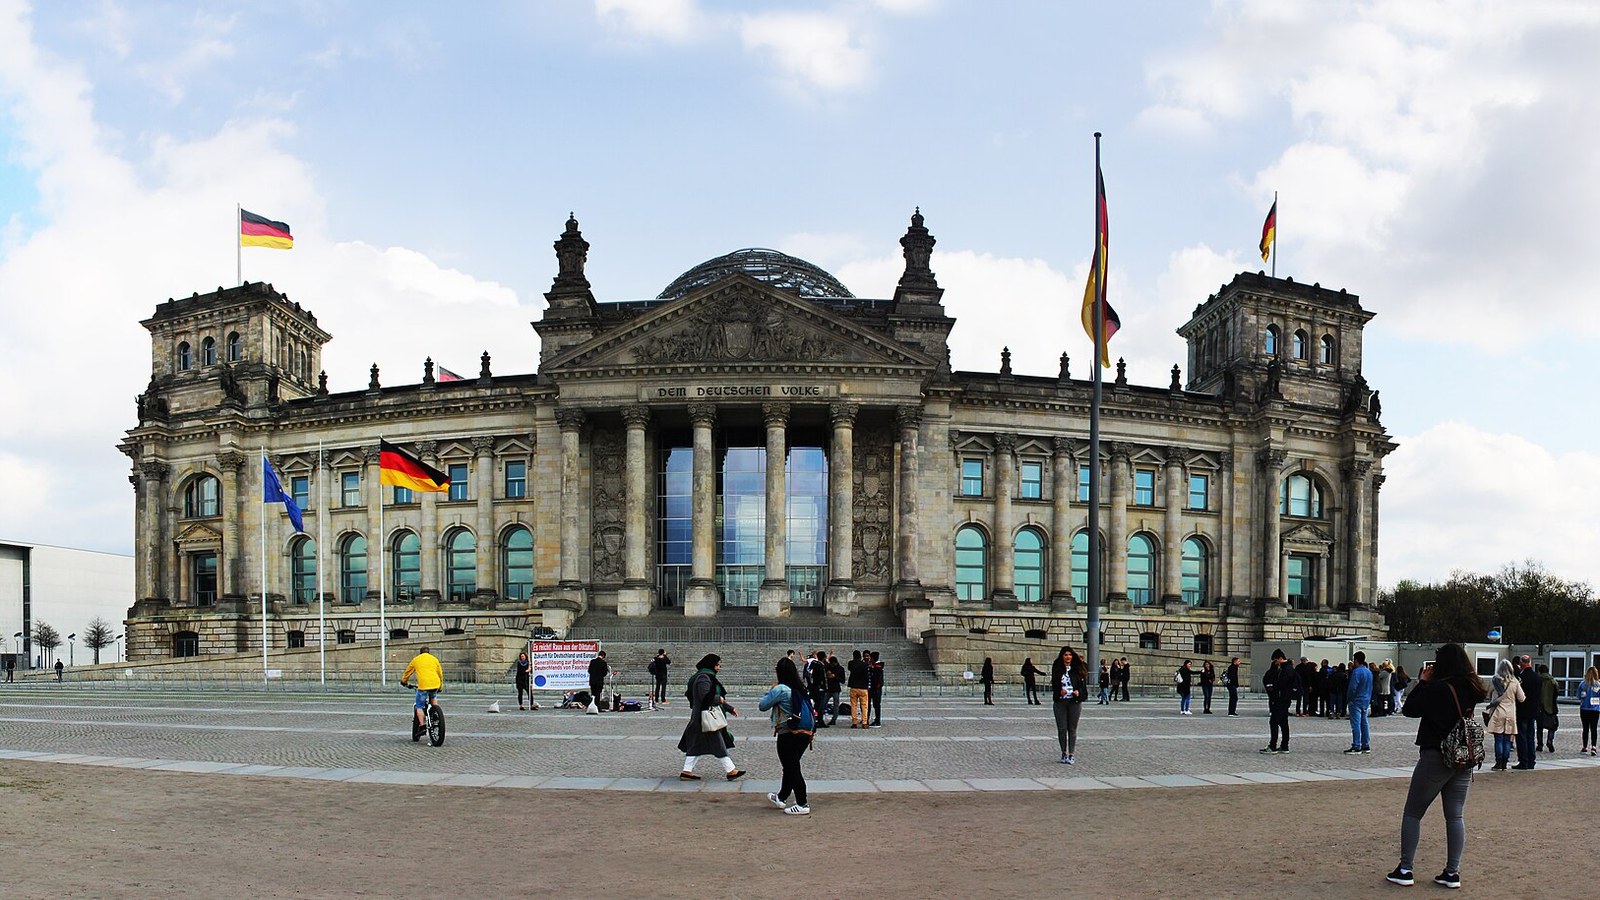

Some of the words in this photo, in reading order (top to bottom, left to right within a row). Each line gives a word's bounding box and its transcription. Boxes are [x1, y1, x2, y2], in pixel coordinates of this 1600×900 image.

[658, 387, 686, 397] DEM
[696, 386, 770, 396] DEUTSCHEN
[781, 386, 820, 396] VOLKE
